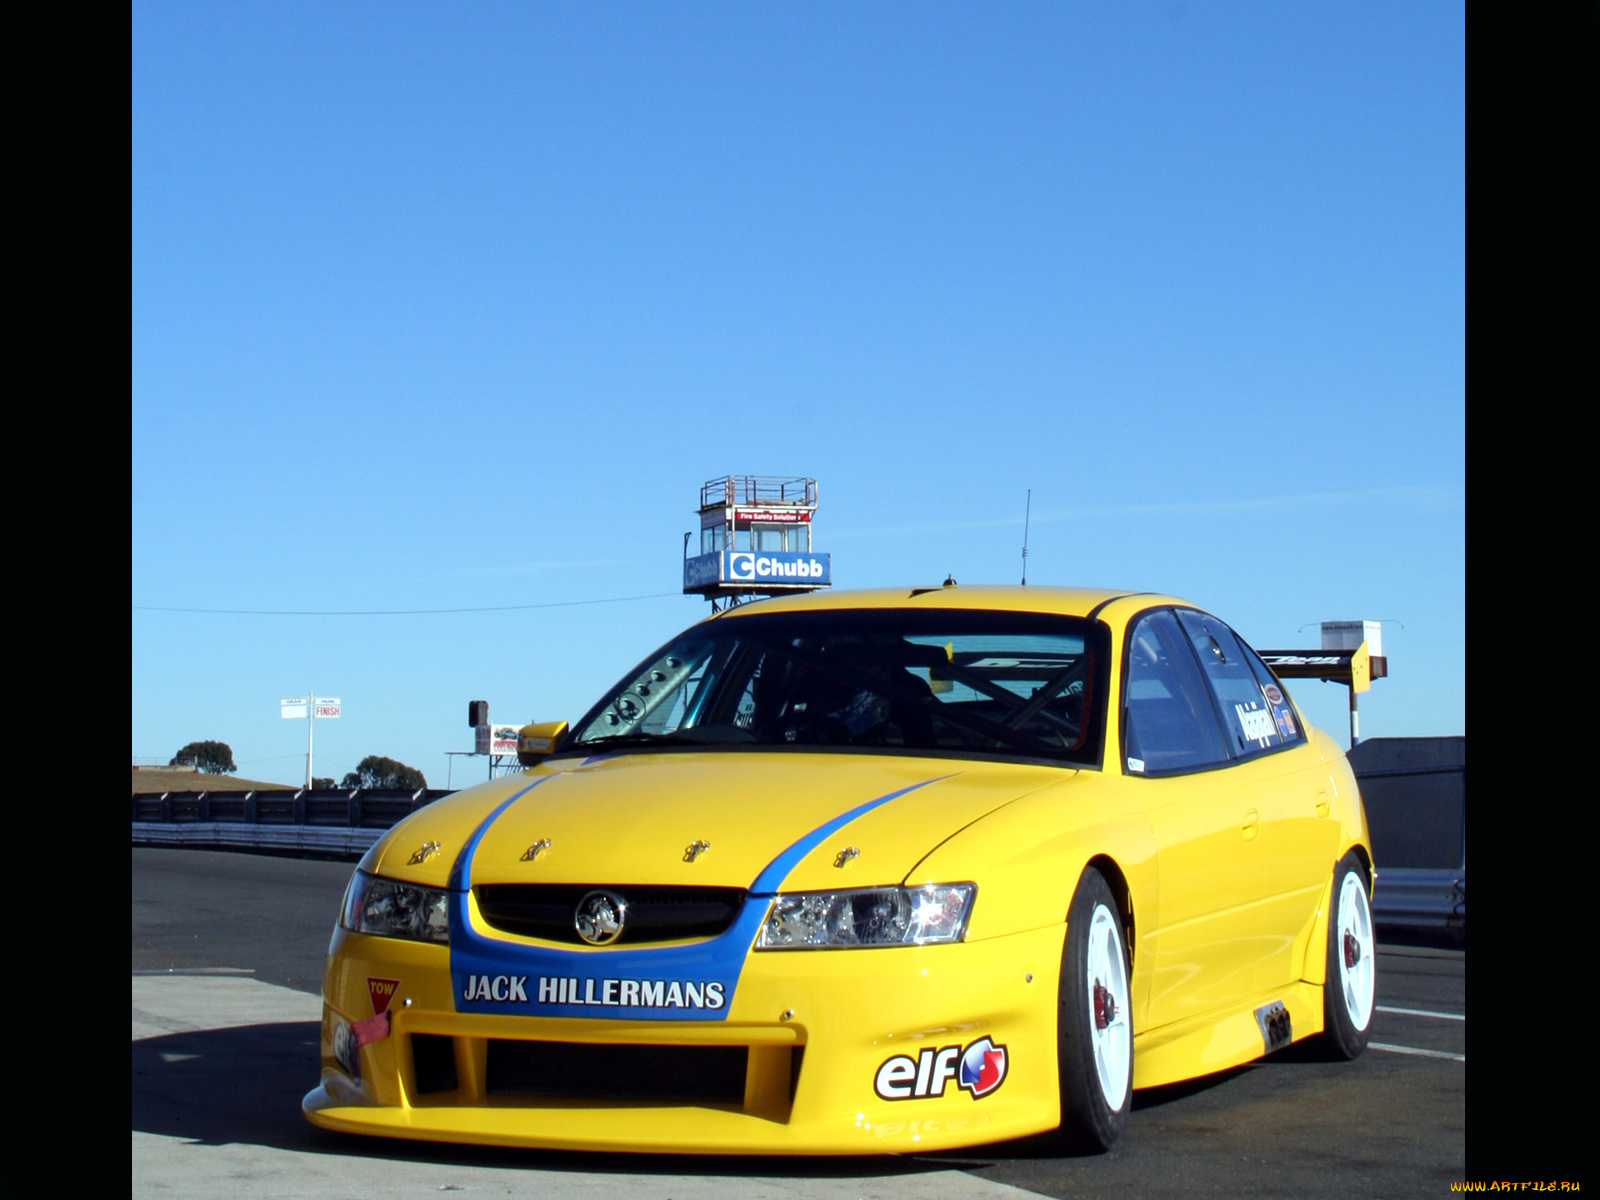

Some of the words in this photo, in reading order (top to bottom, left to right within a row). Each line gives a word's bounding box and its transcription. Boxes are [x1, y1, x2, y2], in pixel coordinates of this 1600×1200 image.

[754, 513, 772, 521] Safety
[756, 557, 823, 578] Chubb
[316, 706, 340, 716] FINISH
[370, 981, 394, 995] TOW
[464, 975, 528, 1001] JACK
[538, 977, 725, 1010] HILLERMANS
[875, 1047, 960, 1099] elf
